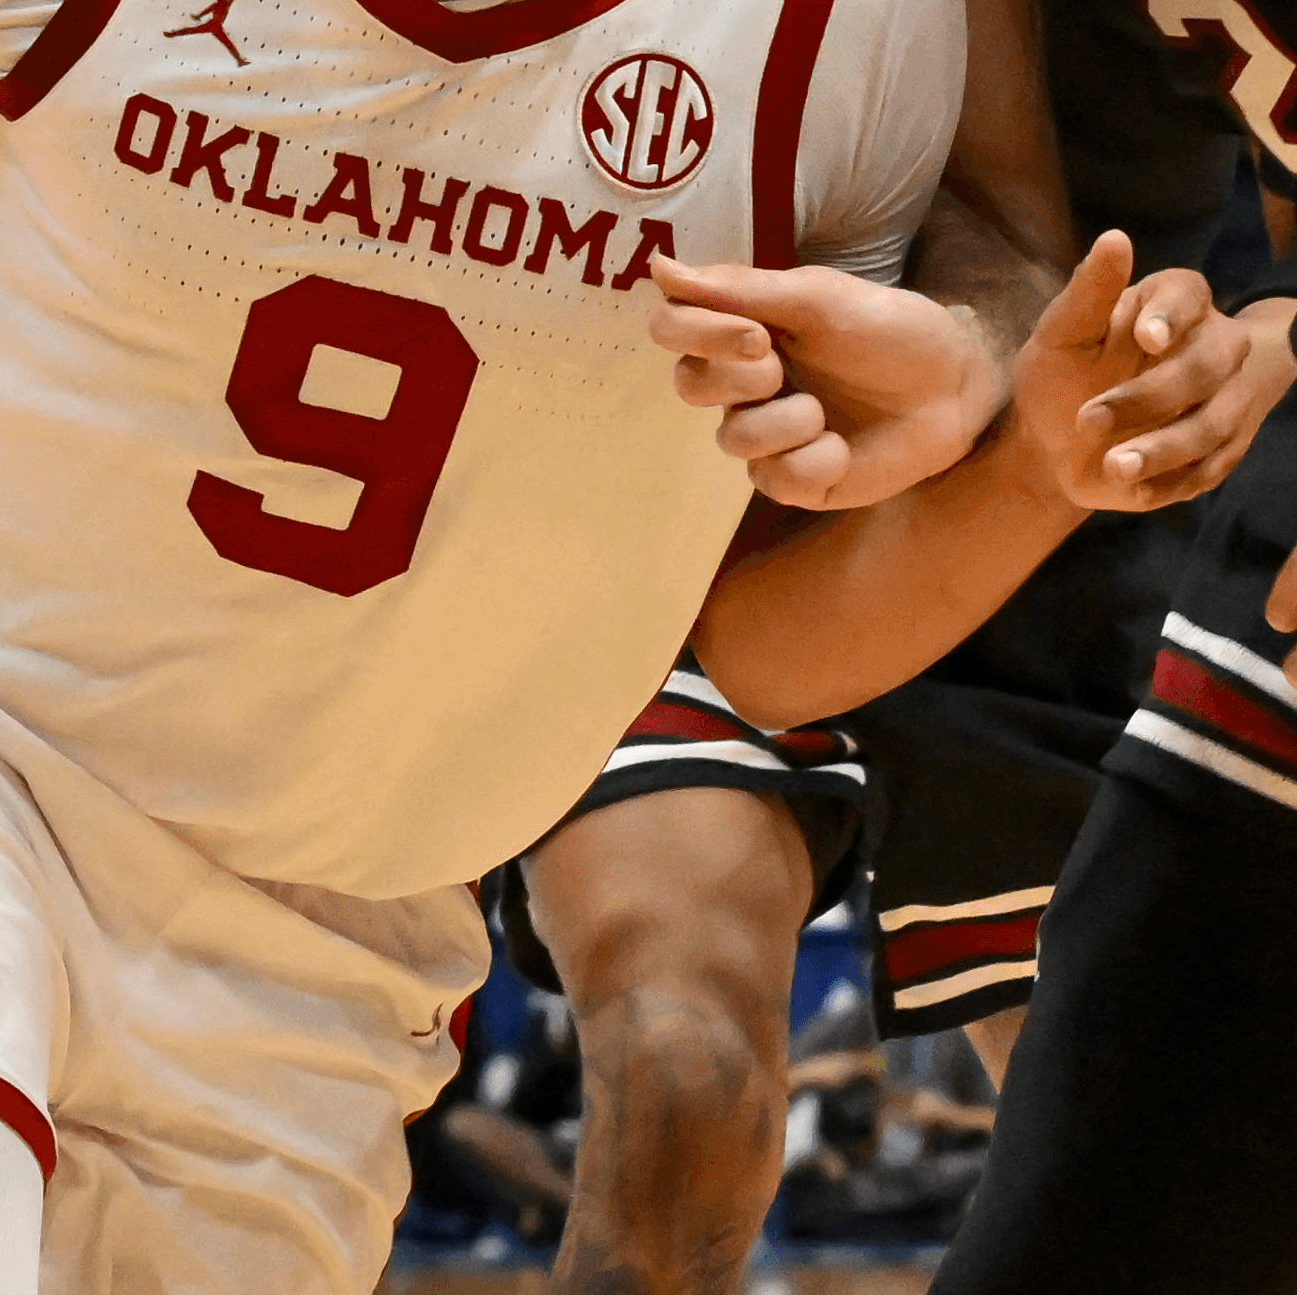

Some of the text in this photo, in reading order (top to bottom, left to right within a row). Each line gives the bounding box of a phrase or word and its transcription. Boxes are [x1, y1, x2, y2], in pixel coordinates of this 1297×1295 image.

[113, 92, 677, 292] OKLAHOMA
[587, 56, 710, 185] SEC
[186, 273, 480, 597] 9
